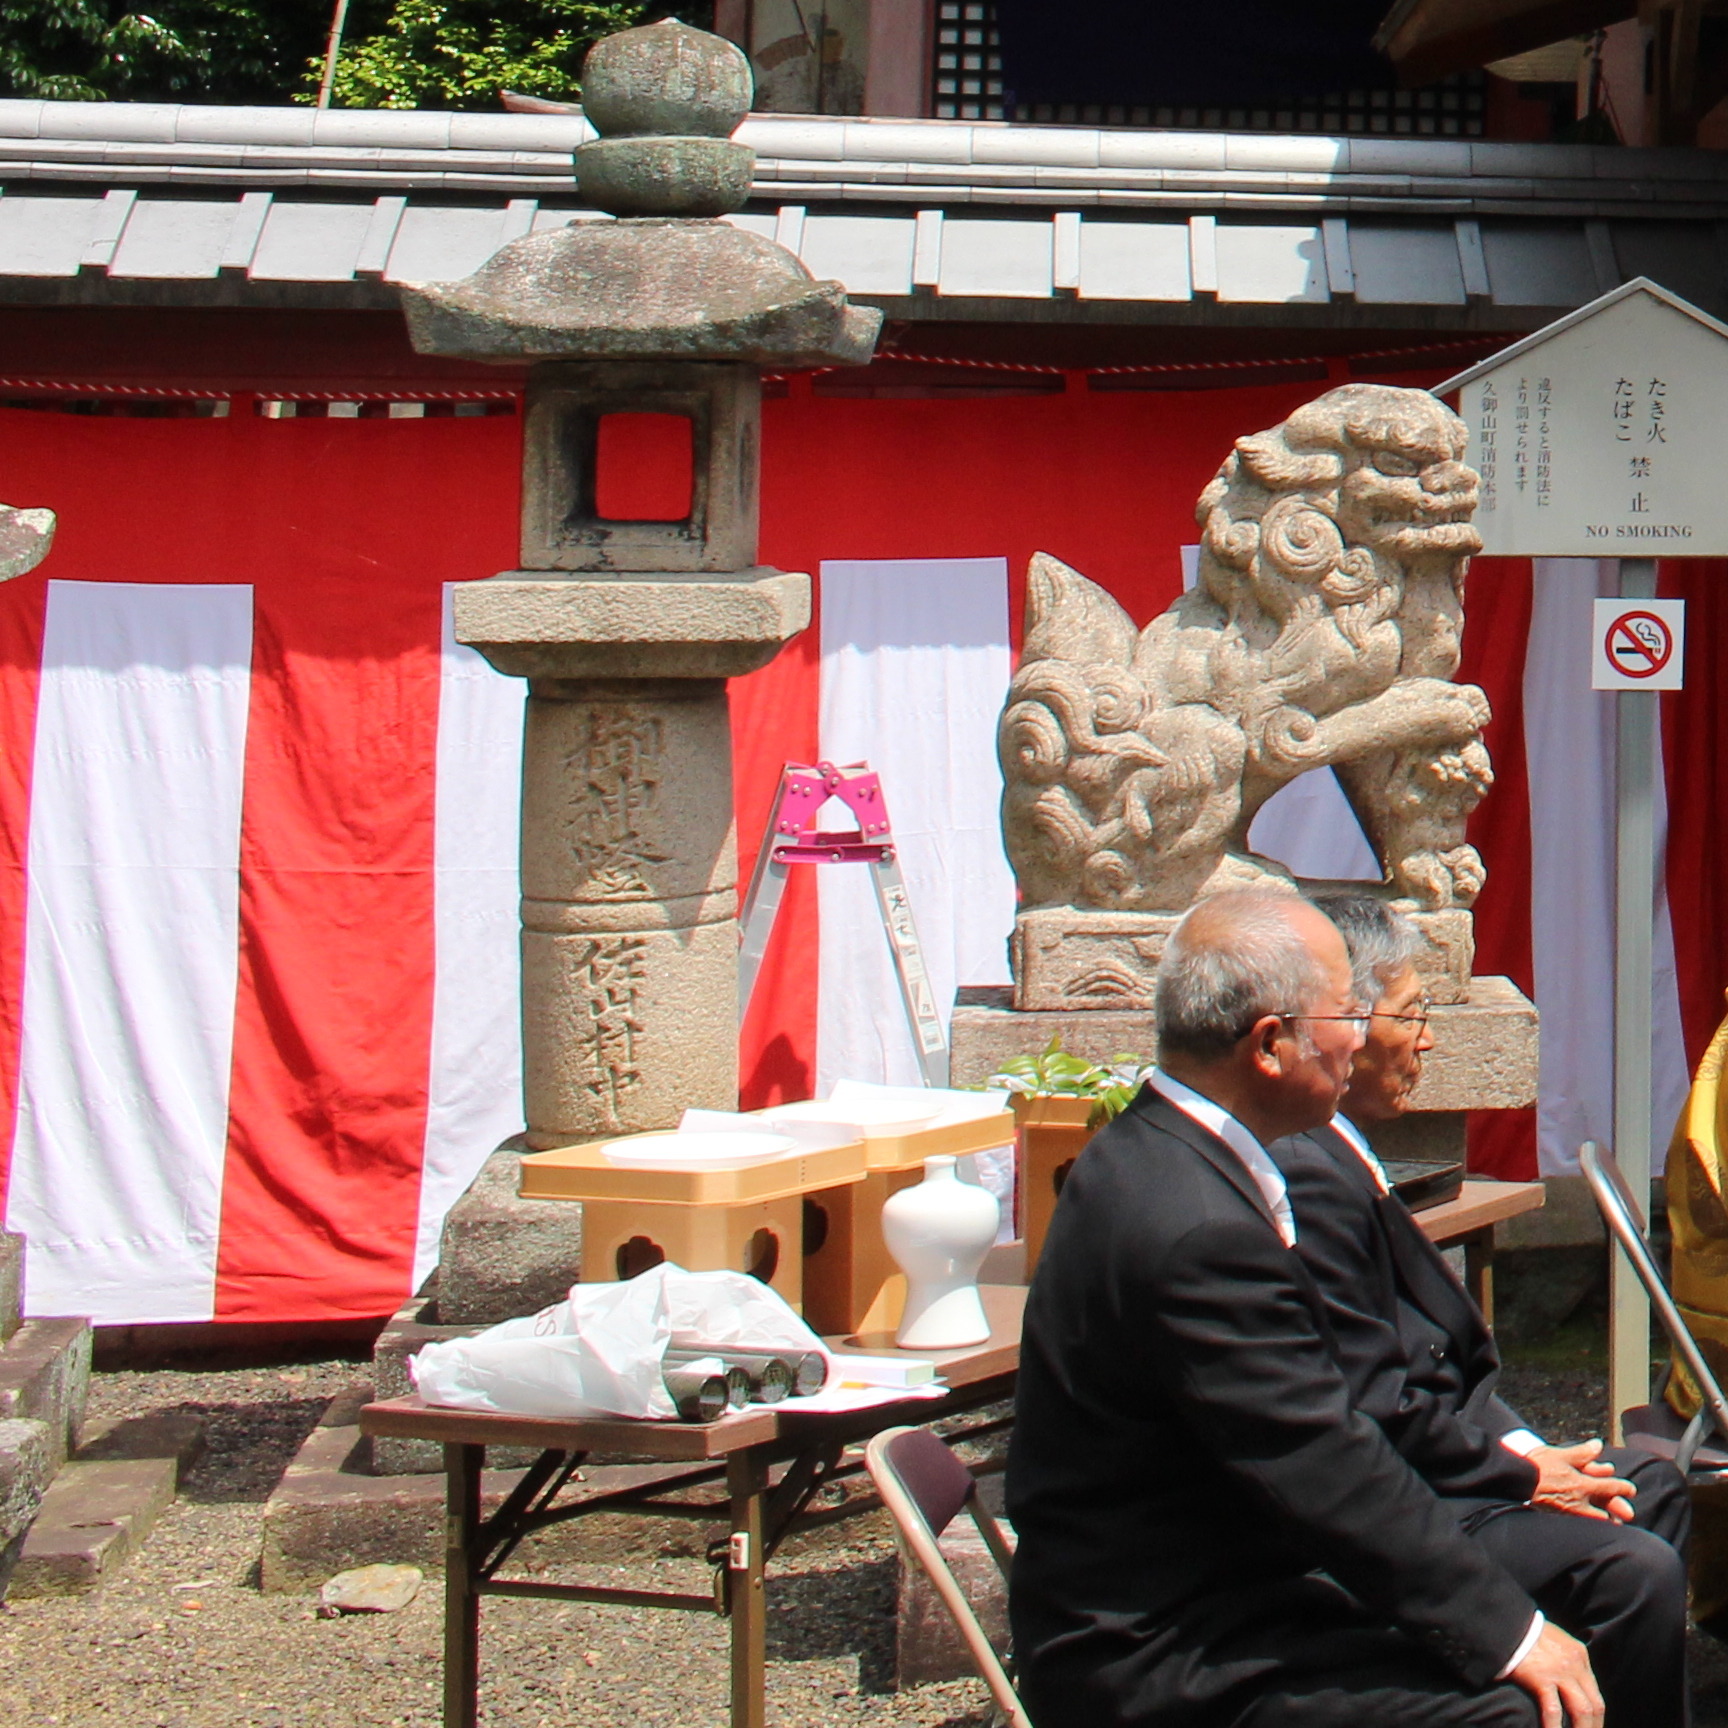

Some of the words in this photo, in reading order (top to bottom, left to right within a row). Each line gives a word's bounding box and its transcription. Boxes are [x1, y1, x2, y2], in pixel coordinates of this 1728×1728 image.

[1480, 381, 1497, 513] 久御山町消防本部
[1515, 377, 1529, 492] より罰せられます
[1536, 377, 1552, 507] 違反すると消防法に
[1613, 377, 1635, 443] たばこ
[1647, 377, 1668, 444] たき火
[1629, 457, 1650, 513] 禁止
[1586, 525, 1609, 538] NO
[1616, 525, 1693, 538] SMOKING
[571, 936, 647, 1122] 佐山村中
